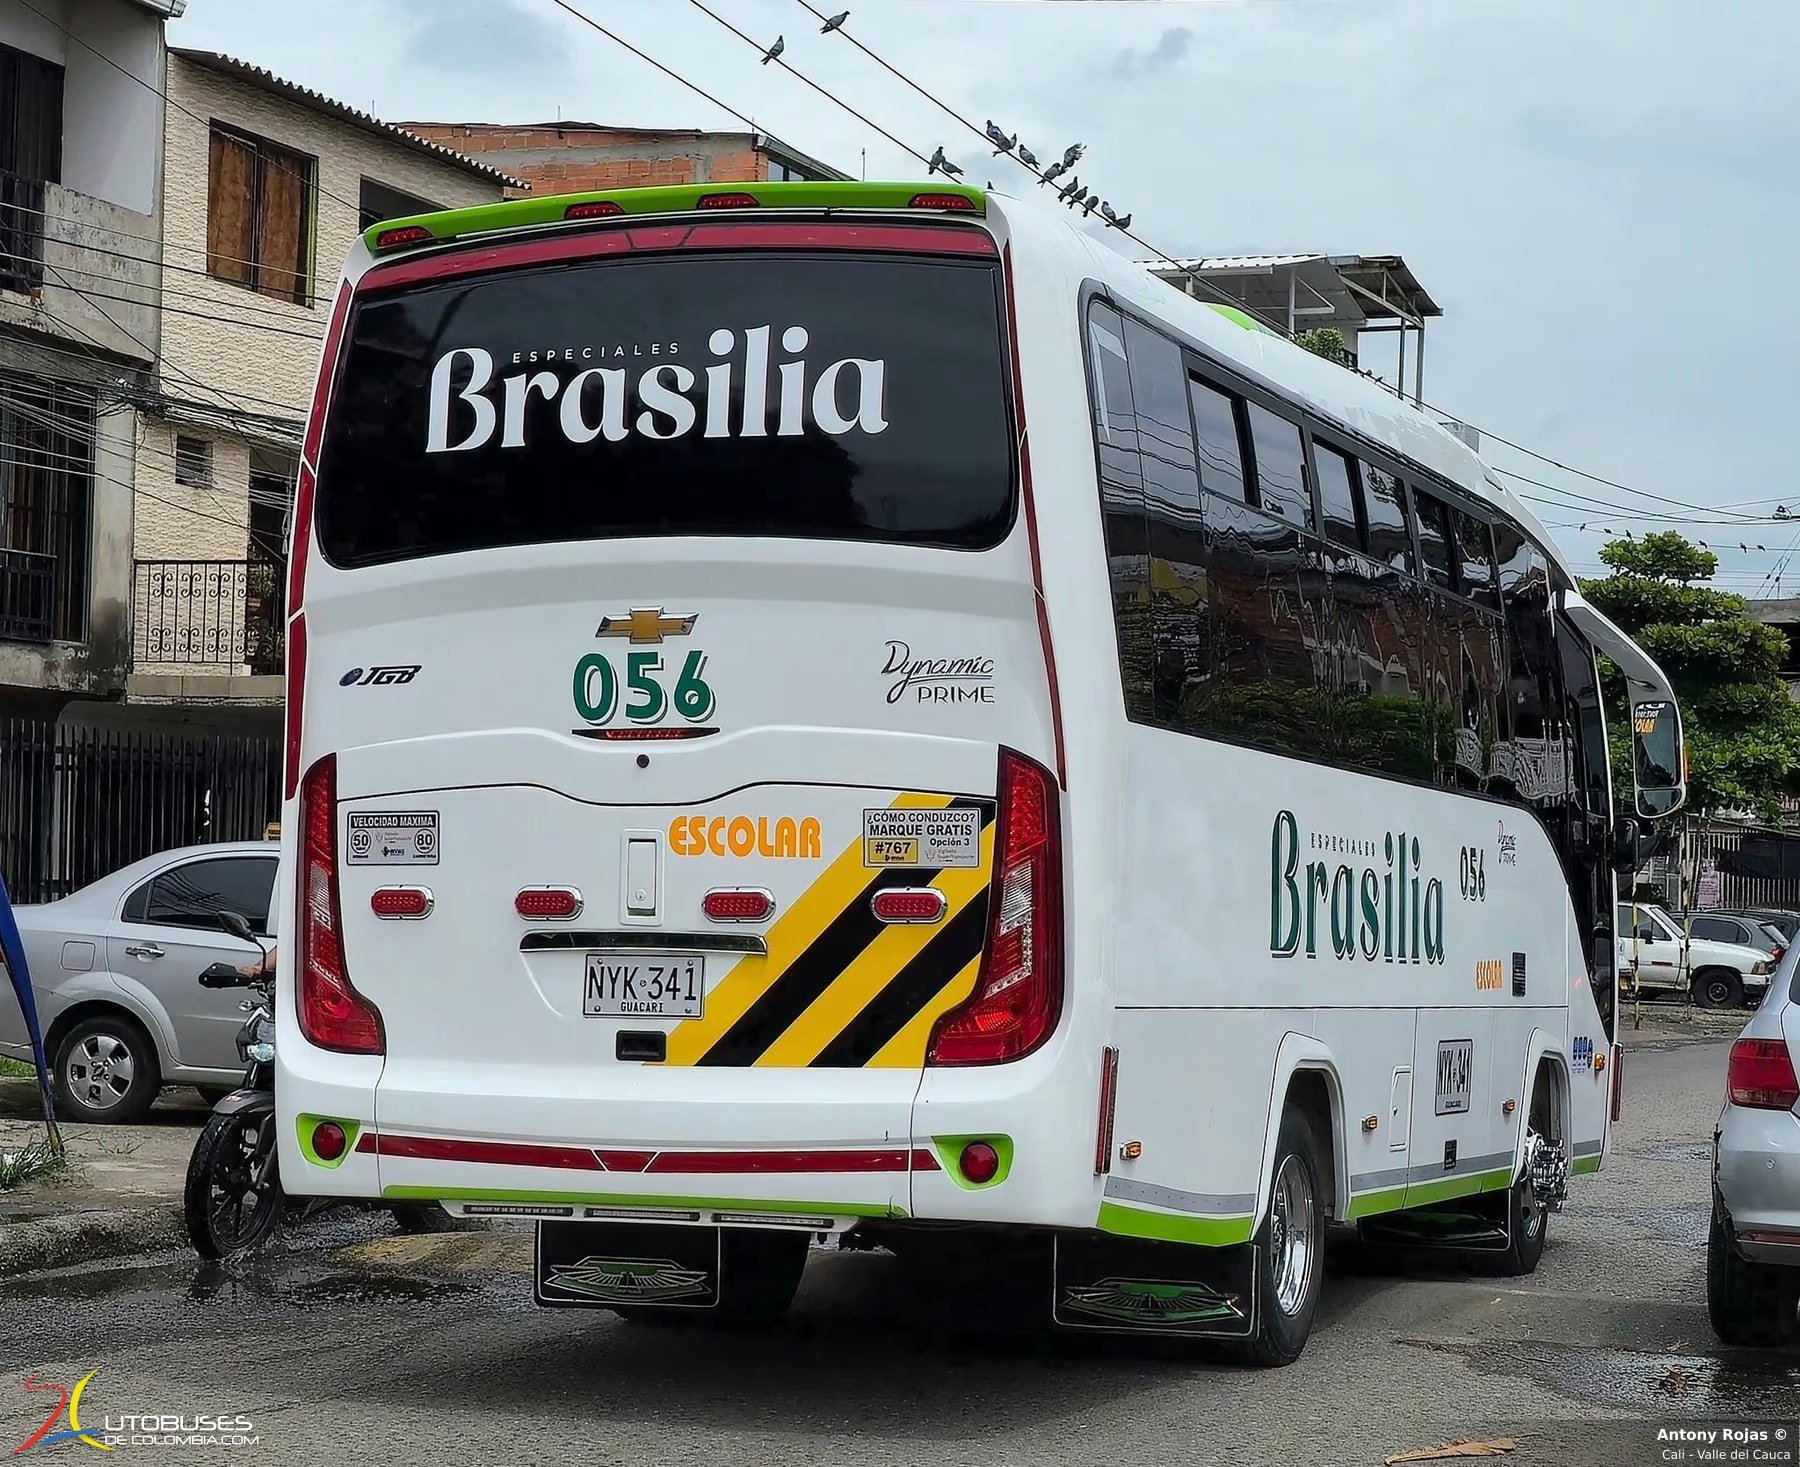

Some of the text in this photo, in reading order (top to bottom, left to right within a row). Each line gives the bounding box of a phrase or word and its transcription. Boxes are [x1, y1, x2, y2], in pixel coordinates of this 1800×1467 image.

[513, 342, 681, 363] ESPECIALES
[425, 325, 889, 454] Brasilia
[357, 664, 423, 686] JGB
[881, 640, 995, 703] Dynamic
[572, 650, 717, 725] 056
[918, 686, 995, 704] PRIME
[353, 816, 434, 827] VELOCIDAD MAXIMA
[867, 811, 976, 824] ¿CÓMO CONDUZCO?
[353, 834, 369, 847] 50
[416, 833, 433, 846] 80
[668, 815, 822, 859] ESCOLAR
[869, 824, 973, 836] MARQUE GRATIS
[875, 841, 911, 854] #767
[930, 838, 970, 848] Opción 3
[1310, 832, 1376, 857] ESPECIALES
[1460, 845, 1486, 902] 056
[1270, 809, 1446, 965] Brasilia
[588, 965, 697, 1001] NYK 341
[620, 1001, 664, 1014] GUACARI
